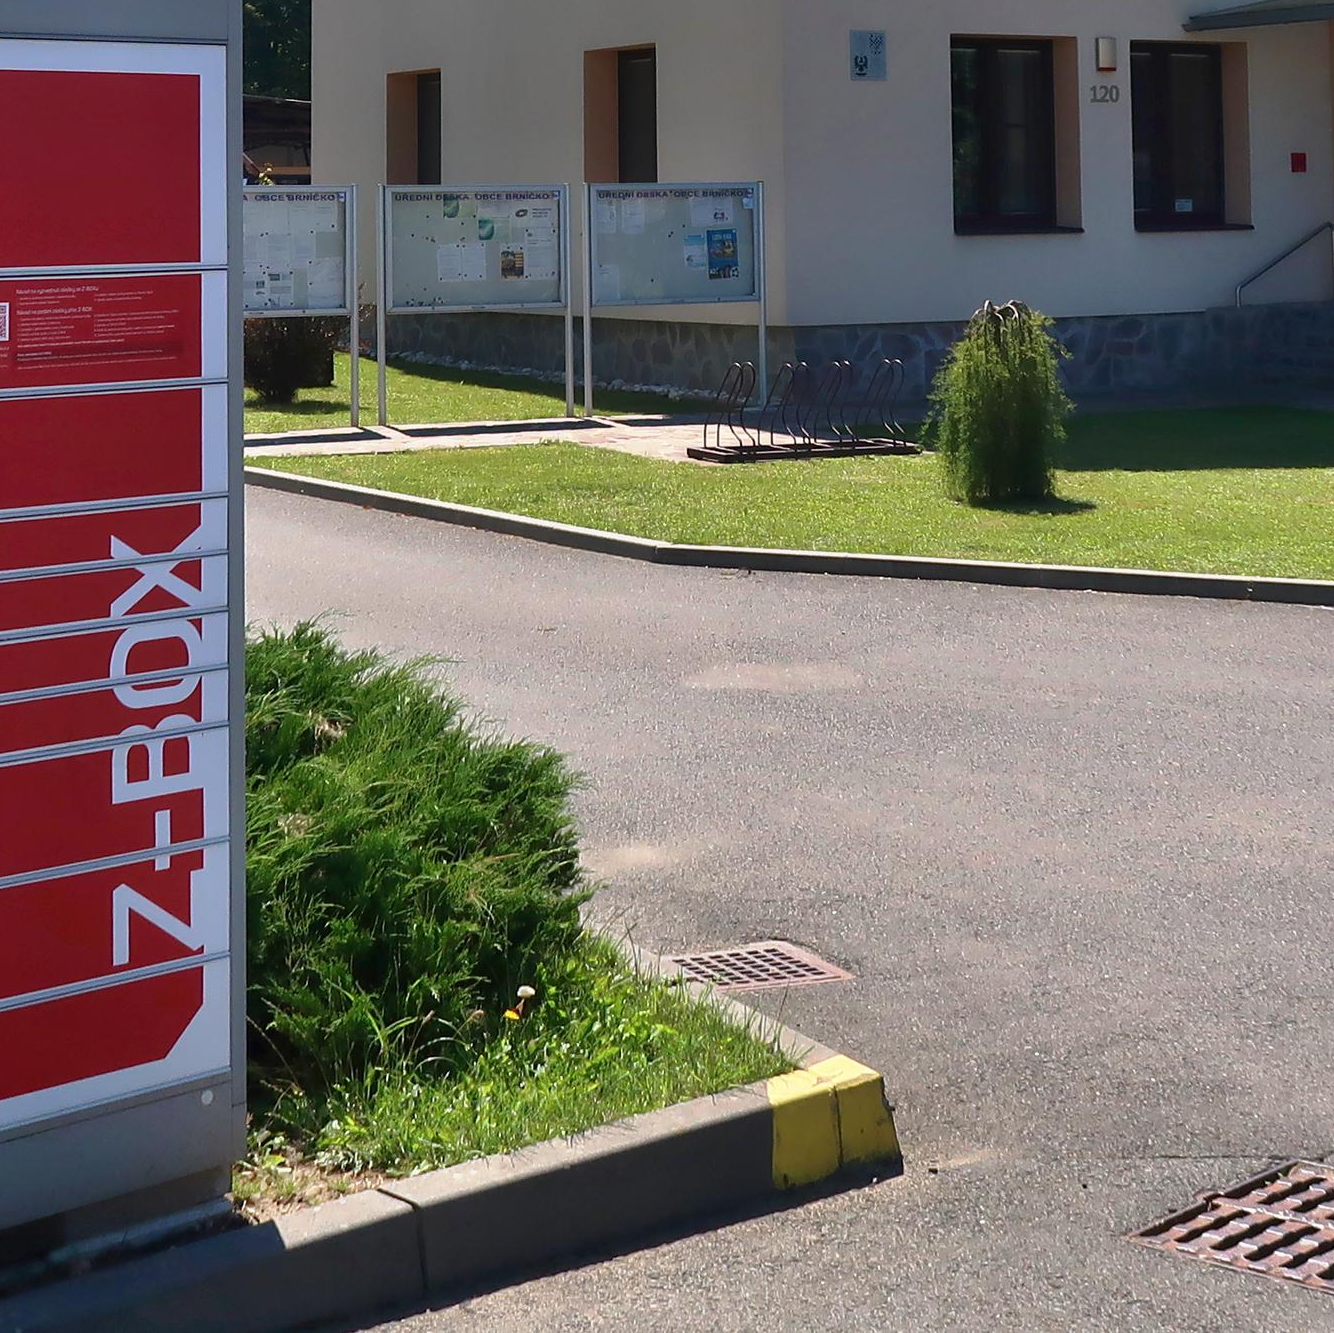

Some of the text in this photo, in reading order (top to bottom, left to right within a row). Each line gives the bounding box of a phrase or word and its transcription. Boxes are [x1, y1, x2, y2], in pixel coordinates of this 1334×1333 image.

[1090, 85, 1120, 103] 120
[475, 193, 505, 201] OBCE
[505, 192, 550, 201] BRNÍČKO
[109, 523, 204, 967] Z-BOX
